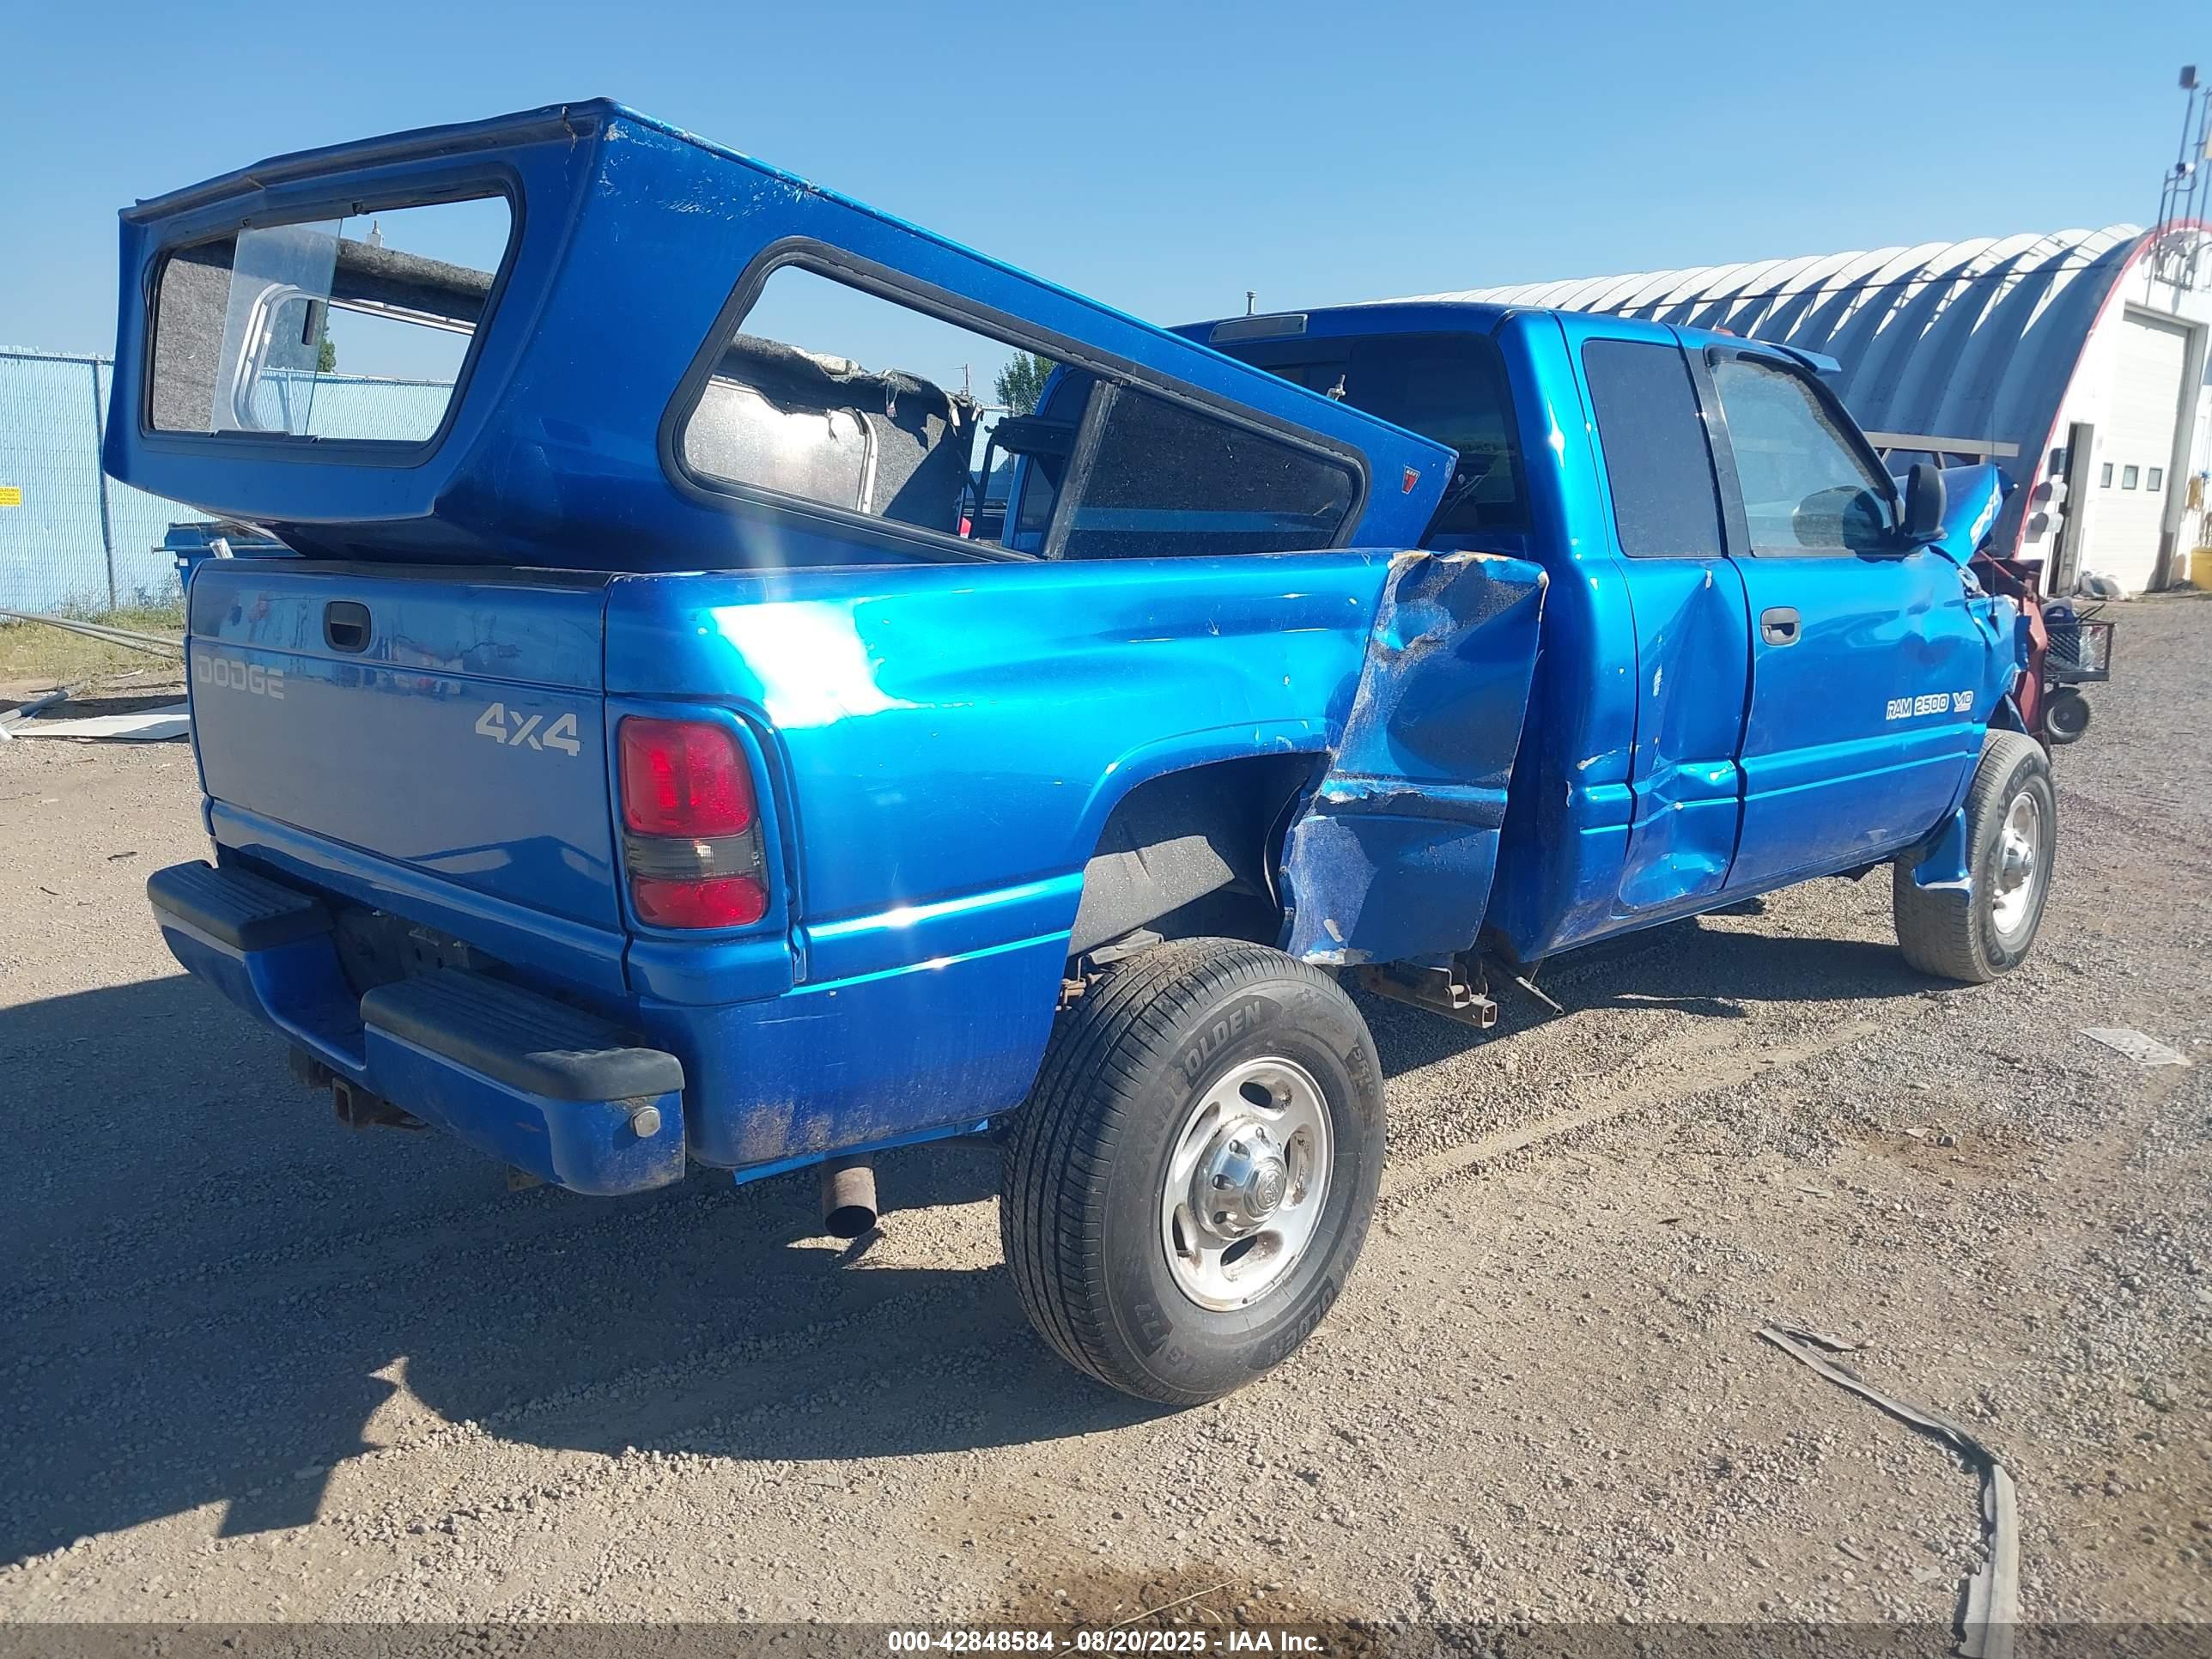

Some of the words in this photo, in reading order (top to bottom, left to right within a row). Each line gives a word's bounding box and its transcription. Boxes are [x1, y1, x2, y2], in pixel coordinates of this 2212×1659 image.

[198, 655, 284, 700] DODGE
[1886, 697, 1912, 720] RAM
[1914, 694, 1949, 717] 2500
